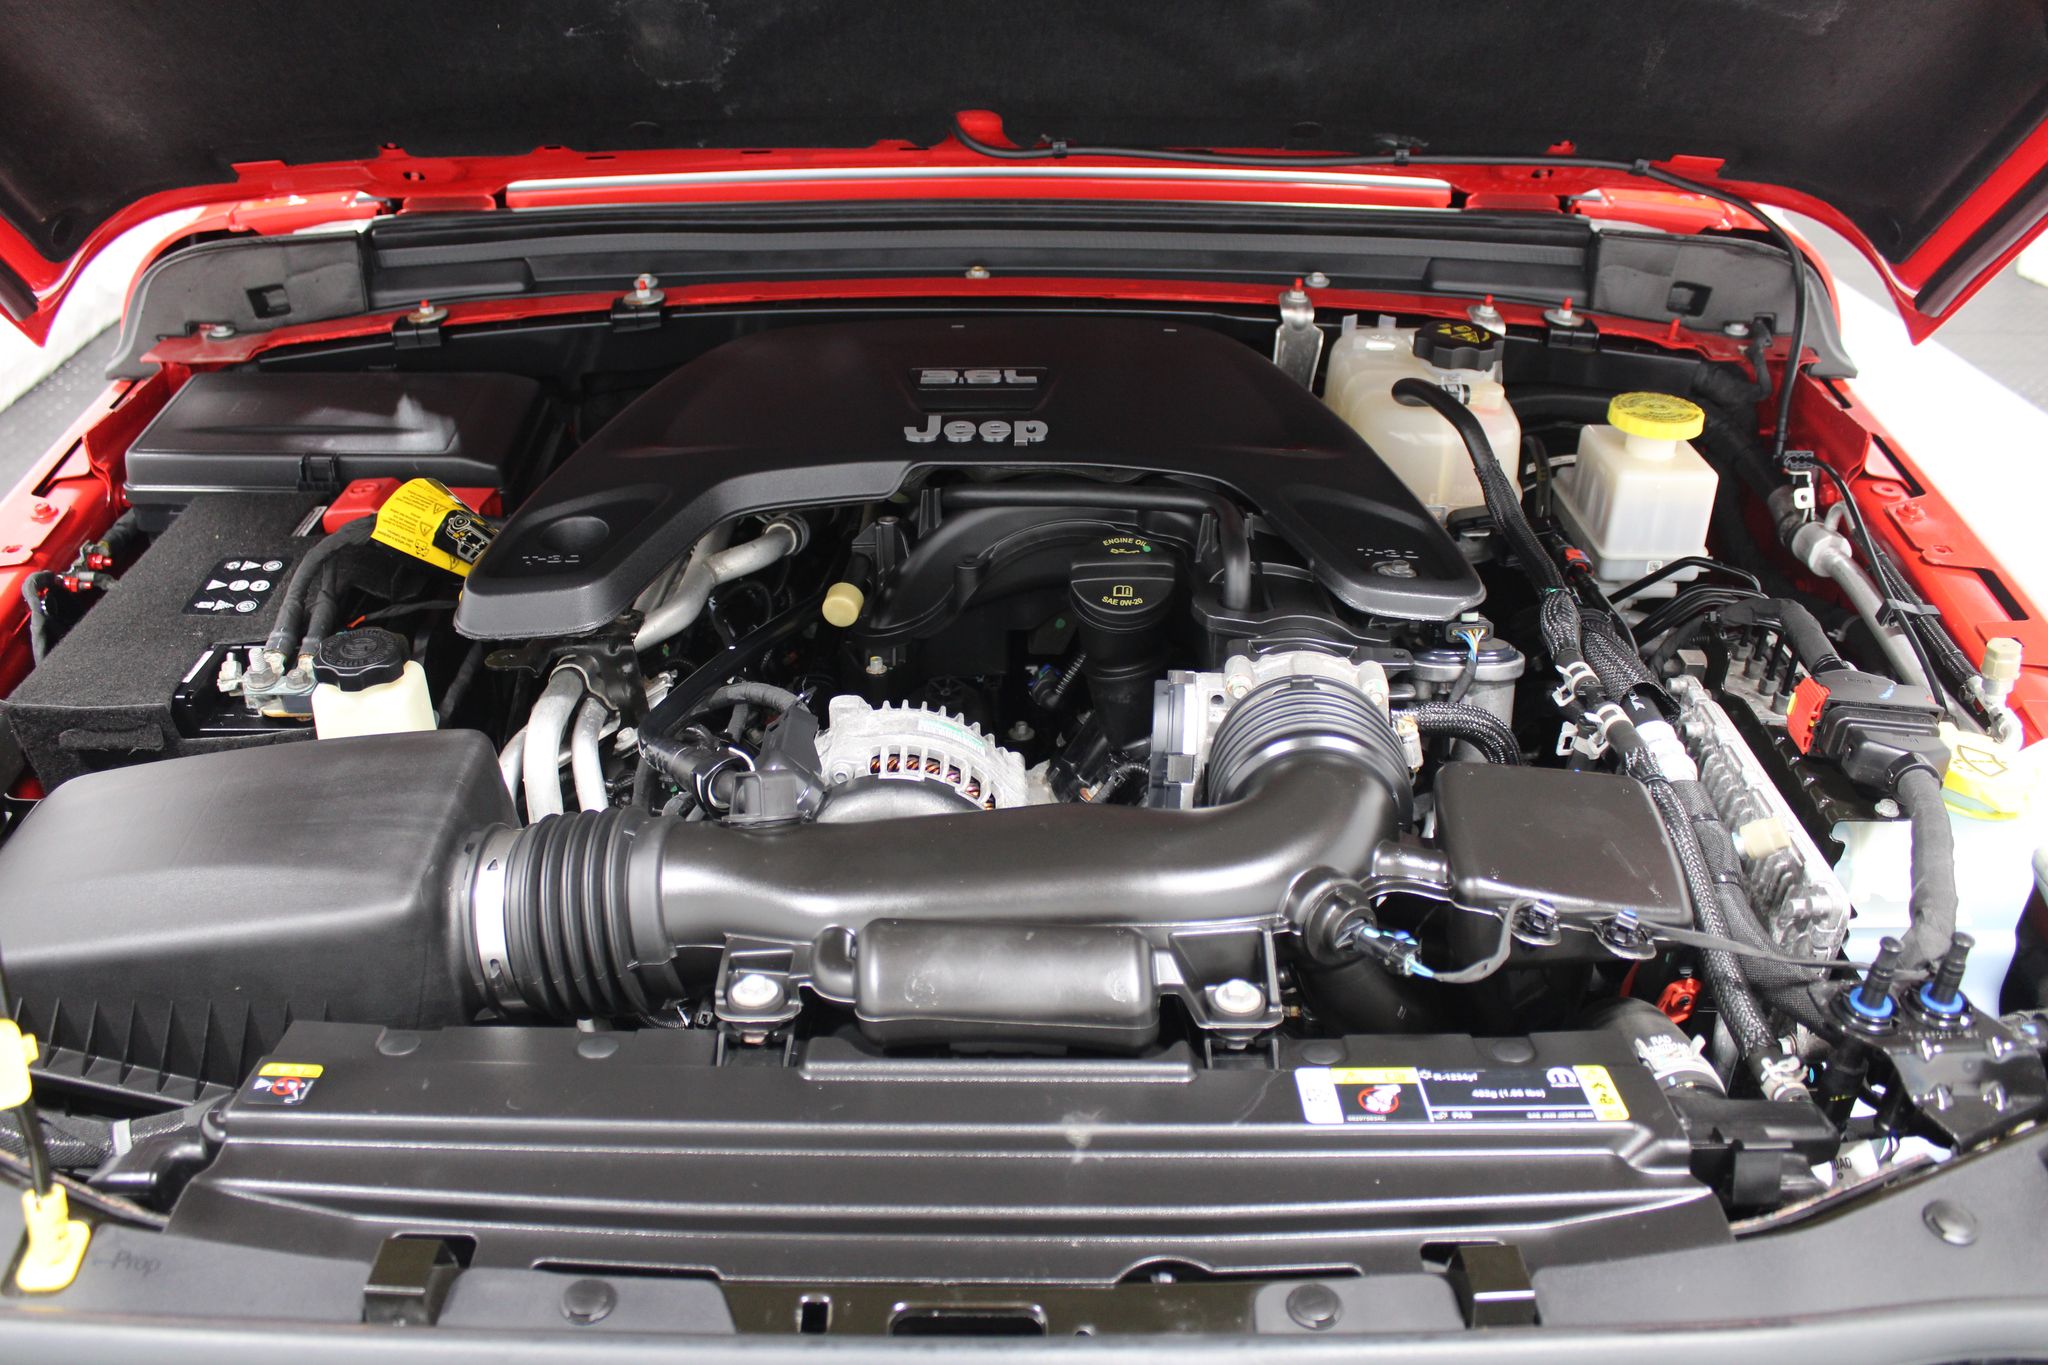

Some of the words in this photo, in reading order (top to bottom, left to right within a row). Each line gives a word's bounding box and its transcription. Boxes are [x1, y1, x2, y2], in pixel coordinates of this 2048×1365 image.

[903, 415, 1049, 446] Jeep
[1102, 537, 1134, 547] ENGINE
[1135, 539, 1147, 547] OIL
[1101, 596, 1118, 606] SAE
[1119, 597, 1144, 607] 0W-20
